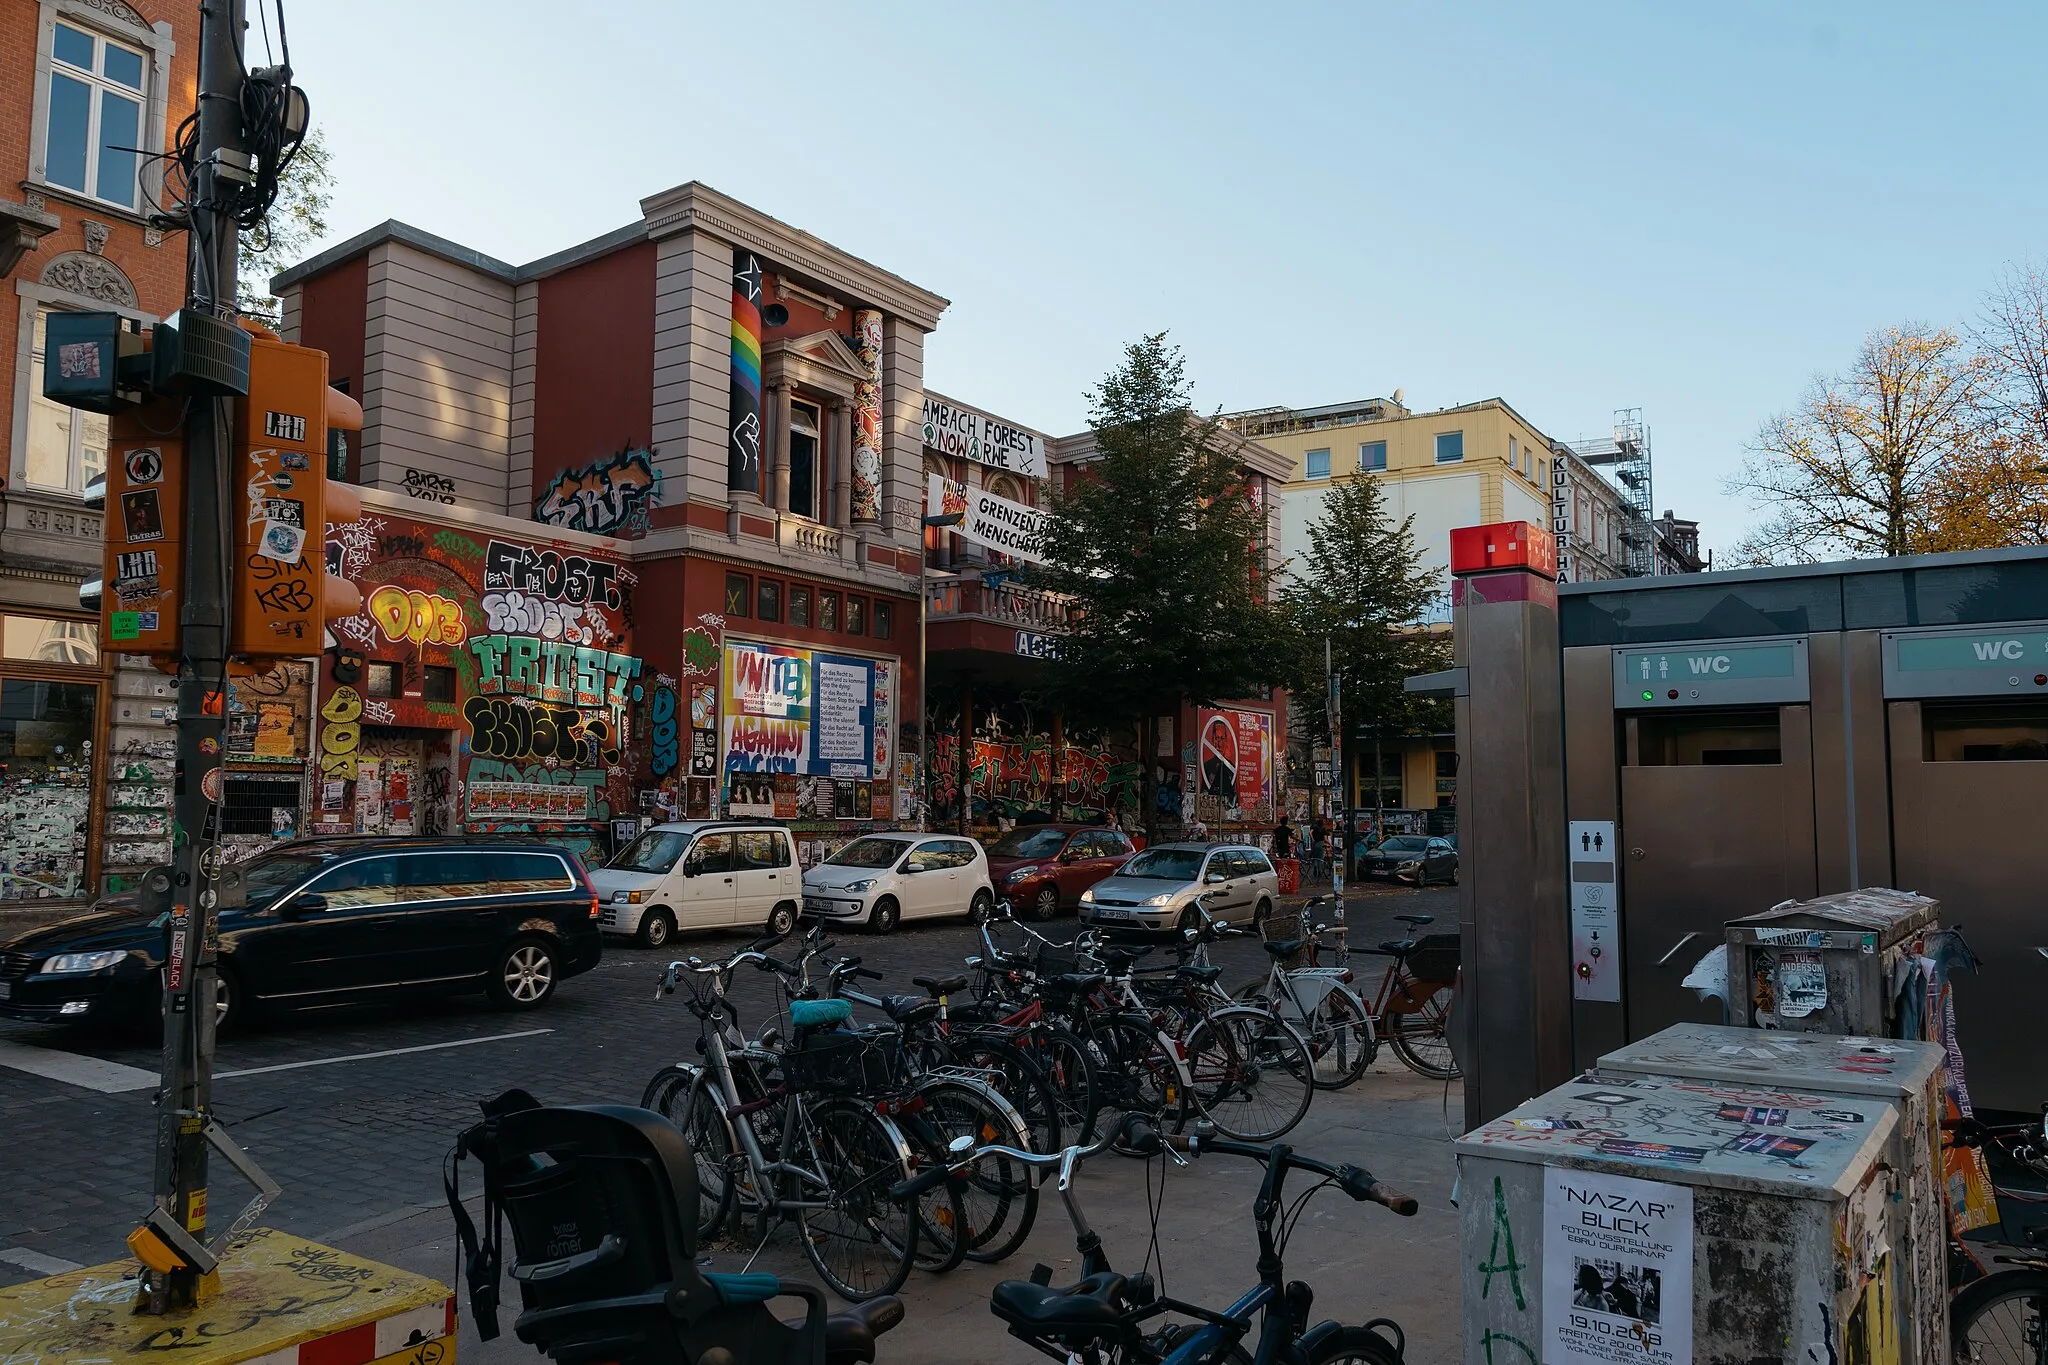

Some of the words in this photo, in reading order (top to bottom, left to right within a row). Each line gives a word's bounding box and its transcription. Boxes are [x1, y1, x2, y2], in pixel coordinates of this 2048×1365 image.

[985, 421, 1034, 455] FOREST
[983, 443, 1010, 468] RWE
[979, 497, 1036, 534] GRENZEN
[129, 530, 162, 542] ULTRAS
[1972, 640, 2024, 661] WC
[737, 651, 810, 704] UNITED
[1688, 656, 1730, 674] WC
[730, 716, 811, 758] AGAINST
[1780, 962, 1822, 972] ANDERSON
[1794, 954, 1810, 962] YUL
[1581, 1211, 1650, 1237] BLICK
[546, 1238, 582, 1258] römer
[1561, 1224, 1673, 1252] FOTOAUSSTELLUNG
[1568, 1234, 1596, 1247] EBRU
[1599, 1241, 1666, 1260] DURUPINAR
[1569, 1314, 1662, 1346] 19.10.2018
[1558, 1327, 1606, 1344] FREITAG
[1609, 1338, 1642, 1354] 20:00
[1646, 1348, 1673, 1361] UHR
[1559, 1336, 1585, 1347] WOHL
[1588, 1342, 1612, 1354] ODER
[1614, 1346, 1638, 1360] ÜBEL
